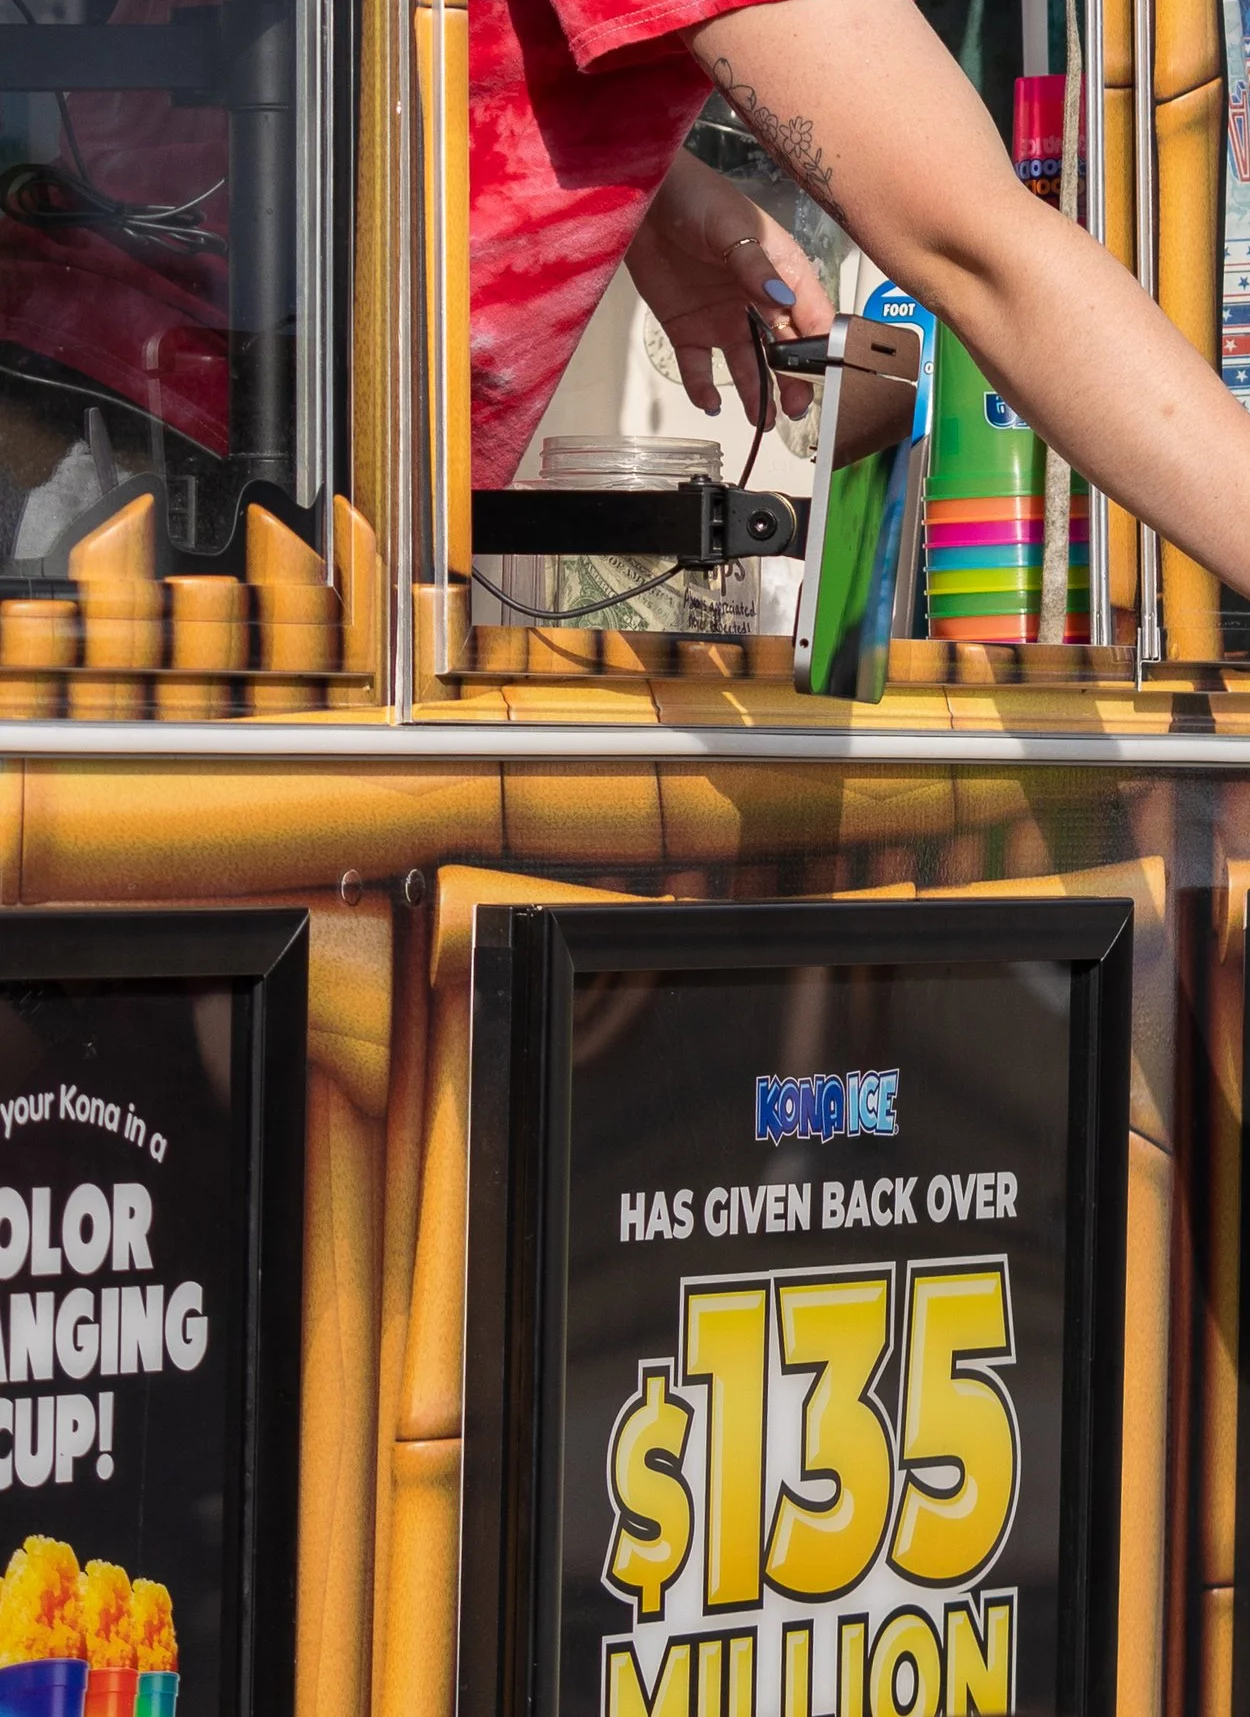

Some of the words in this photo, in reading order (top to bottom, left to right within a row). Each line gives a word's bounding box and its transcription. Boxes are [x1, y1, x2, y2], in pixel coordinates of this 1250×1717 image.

[882, 302, 916, 317] FOOT
[0, 1092, 55, 1140] your
[59, 1083, 121, 1133] Kona
[124, 1102, 147, 1147] in
[150, 1132, 168, 1164] a
[755, 1074, 846, 1147] KONA
[846, 1068, 900, 1137] ICE
[620, 1188, 695, 1241] HAS
[704, 1180, 810, 1237] GIVEN
[821, 1176, 919, 1229] BACK
[926, 1171, 1018, 1223] OVER
[0, 1281, 208, 1381] NGING
[604, 1258, 1019, 1626] $135
[604, 1592, 1015, 1717] MILLION
